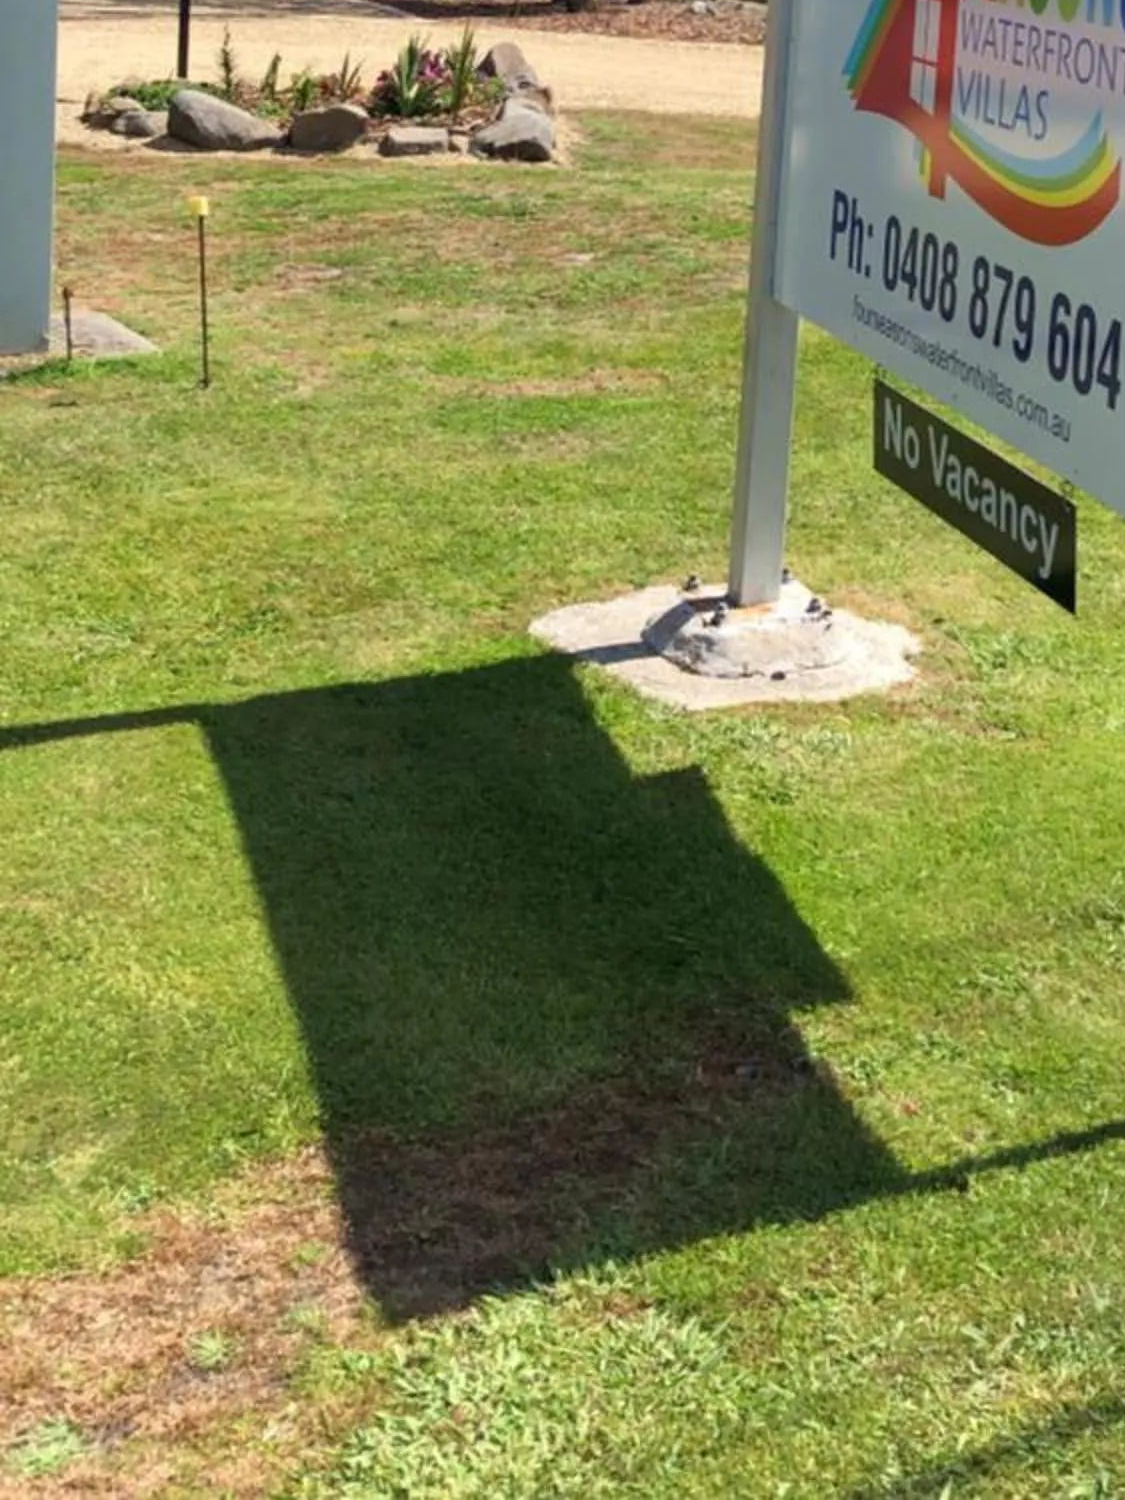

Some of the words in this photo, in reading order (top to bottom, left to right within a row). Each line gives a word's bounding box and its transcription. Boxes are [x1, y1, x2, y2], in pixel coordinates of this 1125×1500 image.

[956, 66, 1050, 142] VILLAS
[830, 189, 874, 280] Ph:
[882, 214, 959, 324] 0408
[967, 255, 1037, 363] 879
[1047, 291, 1124, 411] 604
[883, 395, 919, 469] No
[928, 424, 1059, 580] Vacancy
